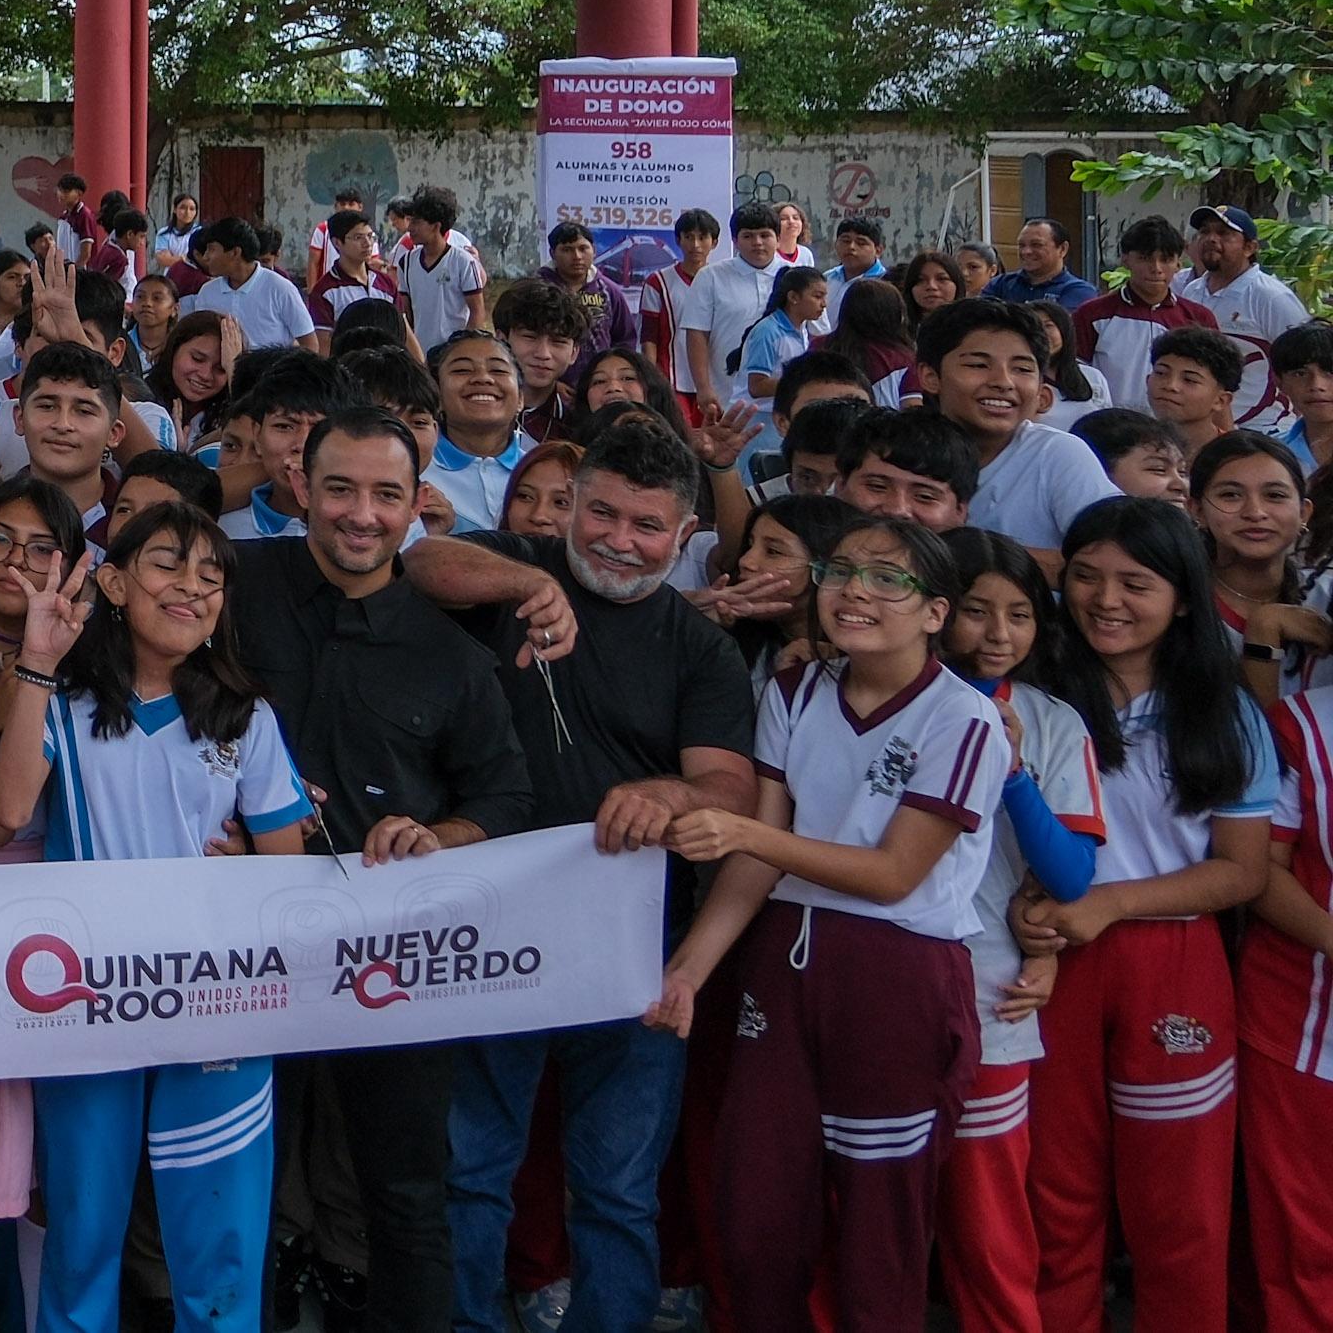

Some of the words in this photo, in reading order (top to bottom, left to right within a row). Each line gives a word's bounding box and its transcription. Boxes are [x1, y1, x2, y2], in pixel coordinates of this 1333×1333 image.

[553, 77, 715, 94] INAUGURACIÓN
[585, 99, 612, 113] DE
[619, 99, 683, 114] DOMO
[549, 118, 562, 127] LA
[564, 118, 629, 127] SECUNDARIA
[672, 119, 699, 128] ROJO
[611, 141, 652, 159] 958
[556, 161, 617, 171] ALUMNAS
[621, 162, 629, 171] Y
[633, 163, 694, 172] ALUMNOS
[578, 173, 671, 184] BENEFICIADOS
[595, 195, 668, 206] INVERSIÓN
[336, 924, 479, 966] NUEVO
[5, 933, 289, 1013] QUINTANA
[188, 985, 242, 1003] UNIDOS
[250, 982, 289, 997] PARA
[86, 988, 183, 1025] ROO
[188, 997, 288, 1018] TRANSFORMAR
